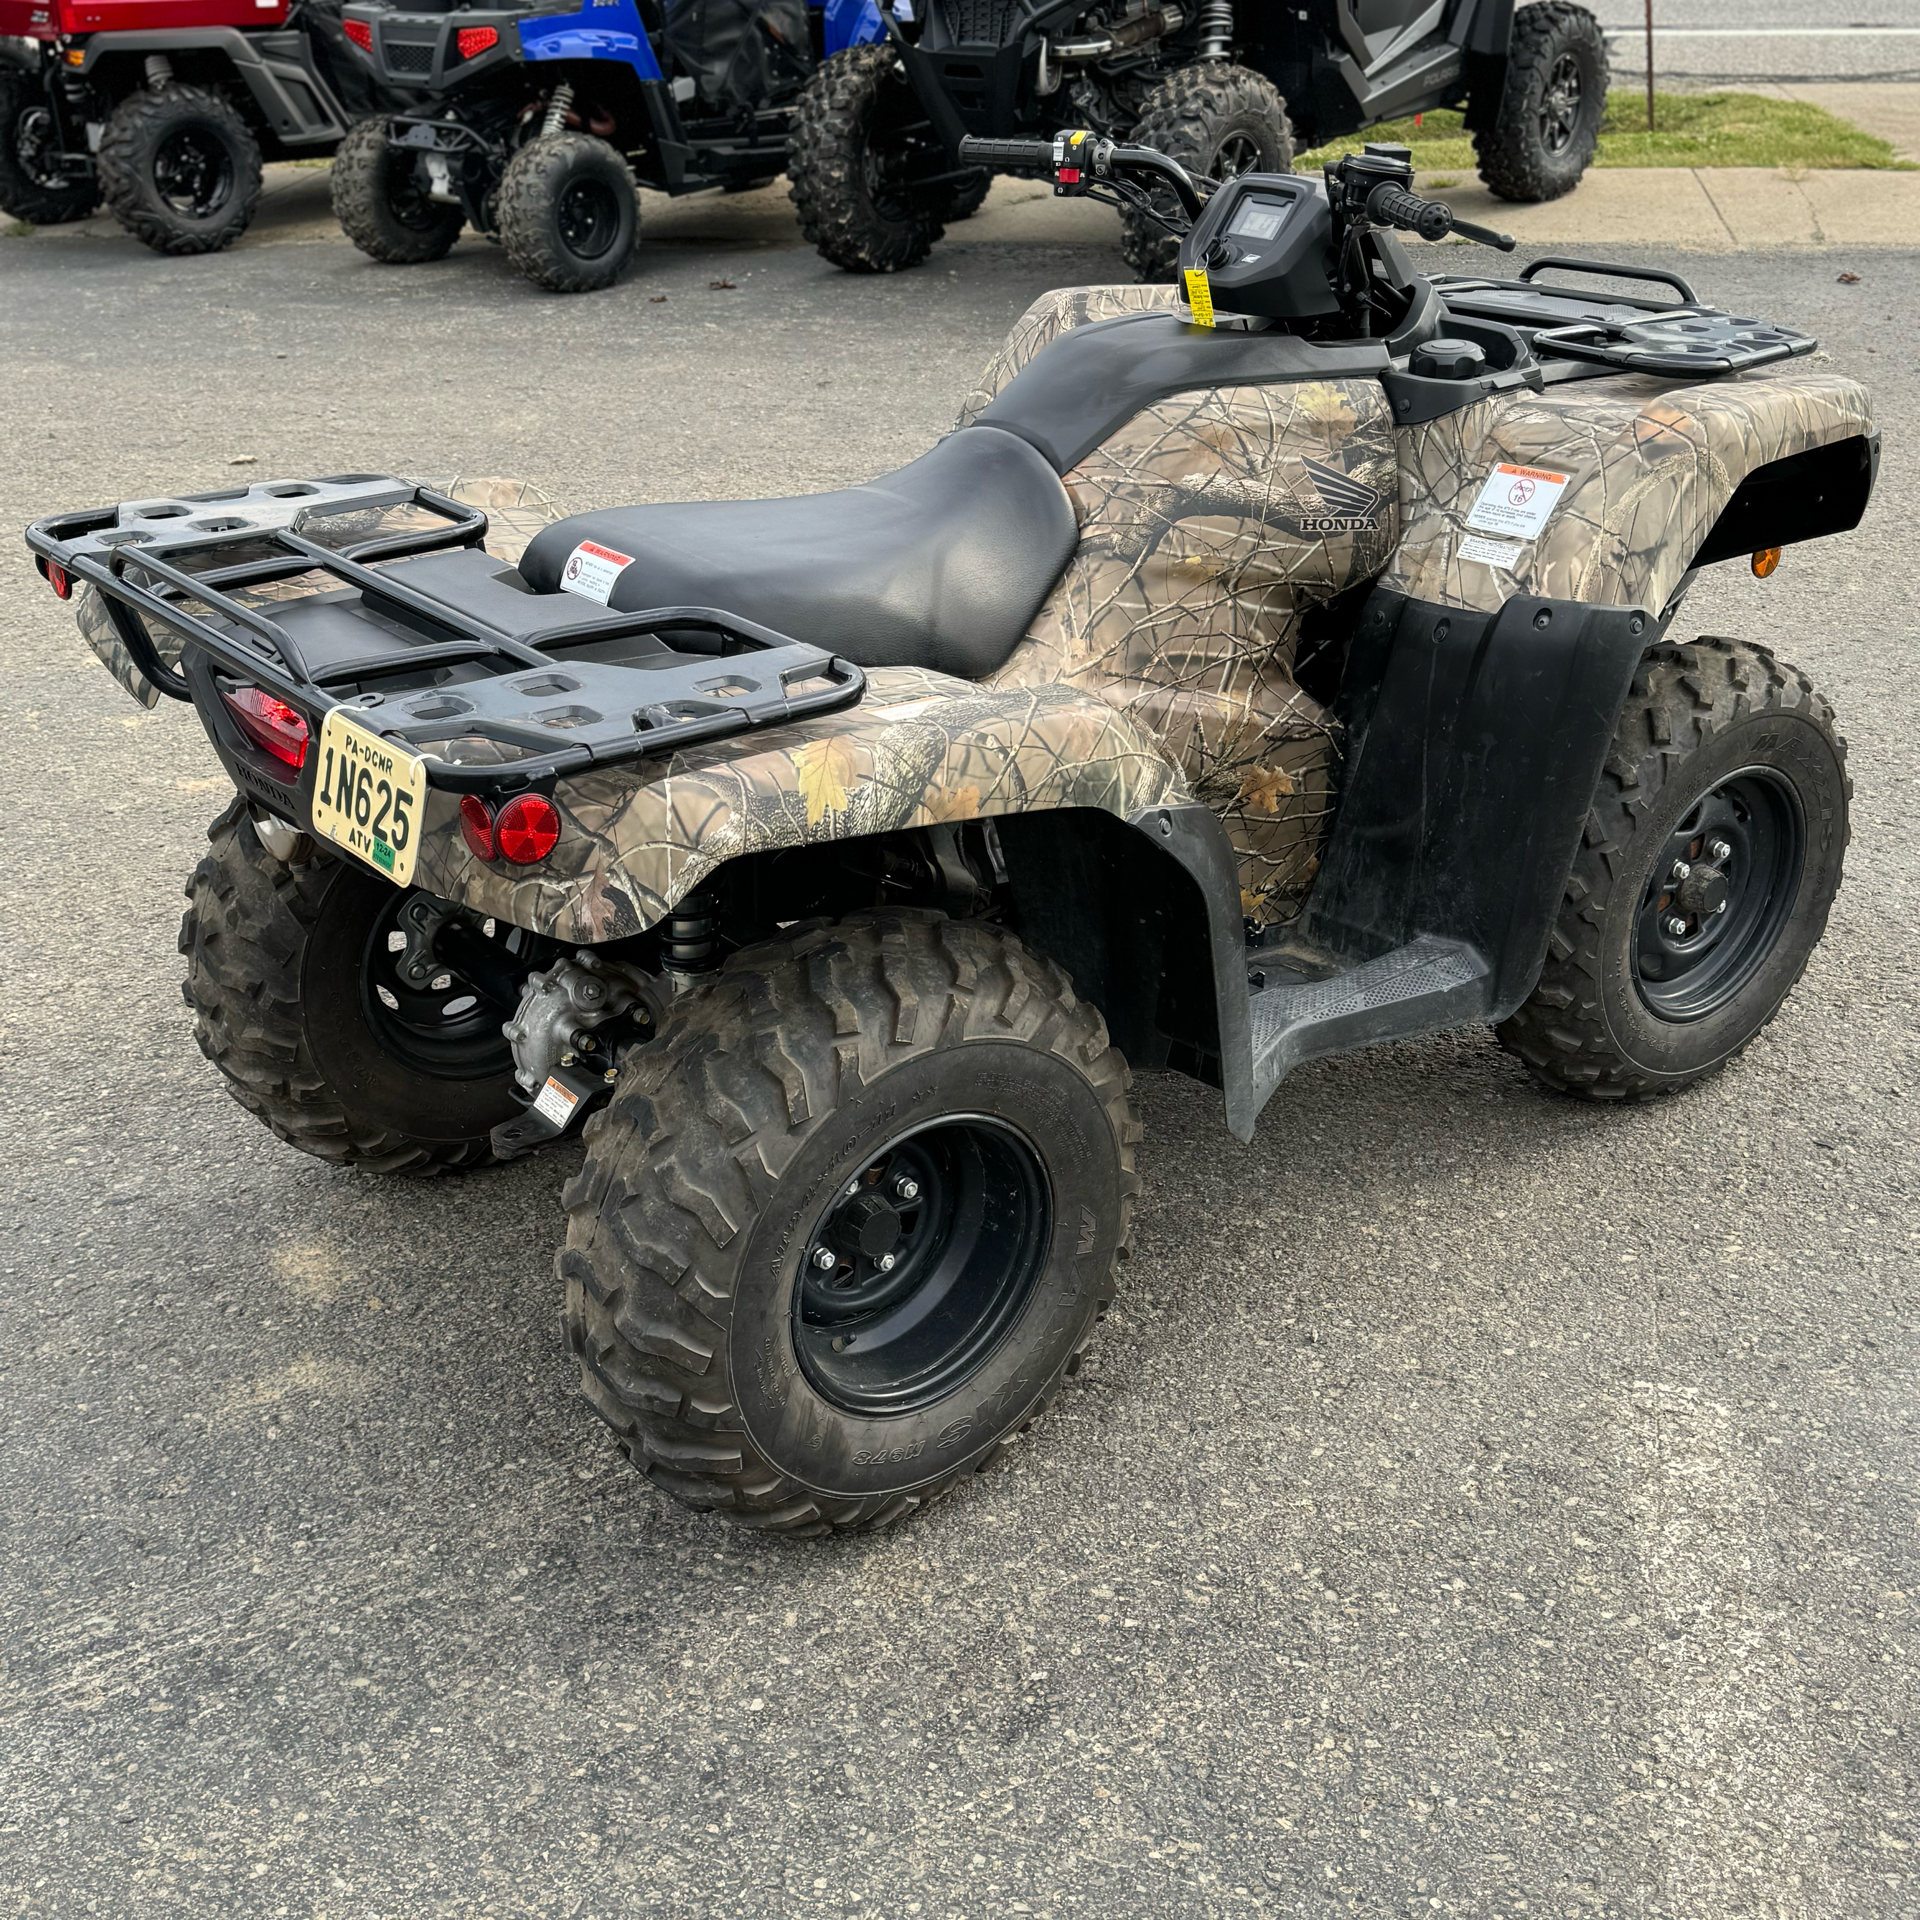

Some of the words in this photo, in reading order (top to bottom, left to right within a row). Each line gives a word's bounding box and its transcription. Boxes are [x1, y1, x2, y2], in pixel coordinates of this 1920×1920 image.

[1519, 468, 1552, 481] WARNING
[1301, 518, 1380, 530] HONDA
[346, 735, 394, 776] PA-DCNR
[234, 761, 298, 812] HONDA
[320, 746, 414, 852] 1N625
[348, 827, 372, 854] ATV
[852, 1440, 926, 1466] M978
